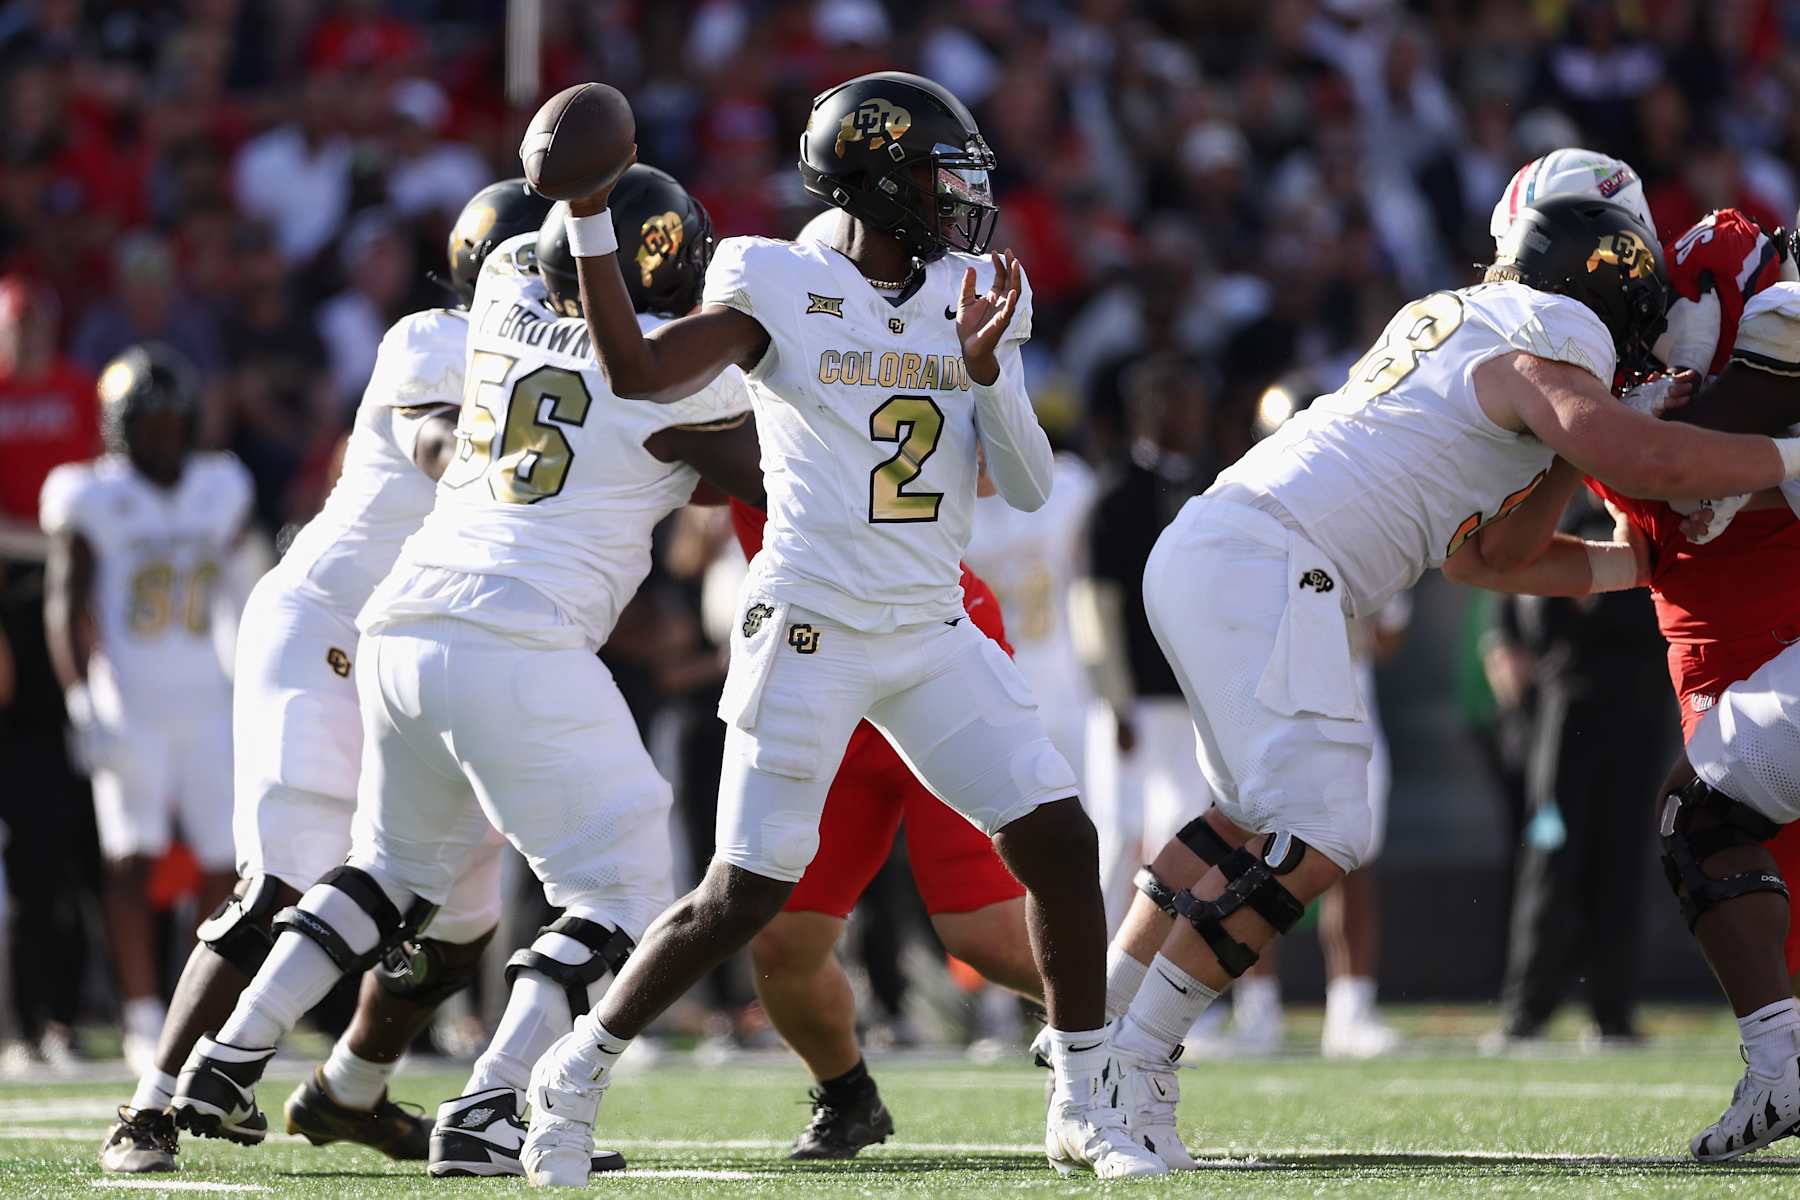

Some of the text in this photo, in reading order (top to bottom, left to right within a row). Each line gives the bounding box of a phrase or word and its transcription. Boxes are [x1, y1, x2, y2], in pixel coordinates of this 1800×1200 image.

[853, 103, 890, 138] CU
[498, 303, 593, 359] BROWN
[888, 318, 905, 334] CU
[443, 349, 592, 505] 56
[869, 395, 944, 523] 2
[788, 623, 820, 654] CU
